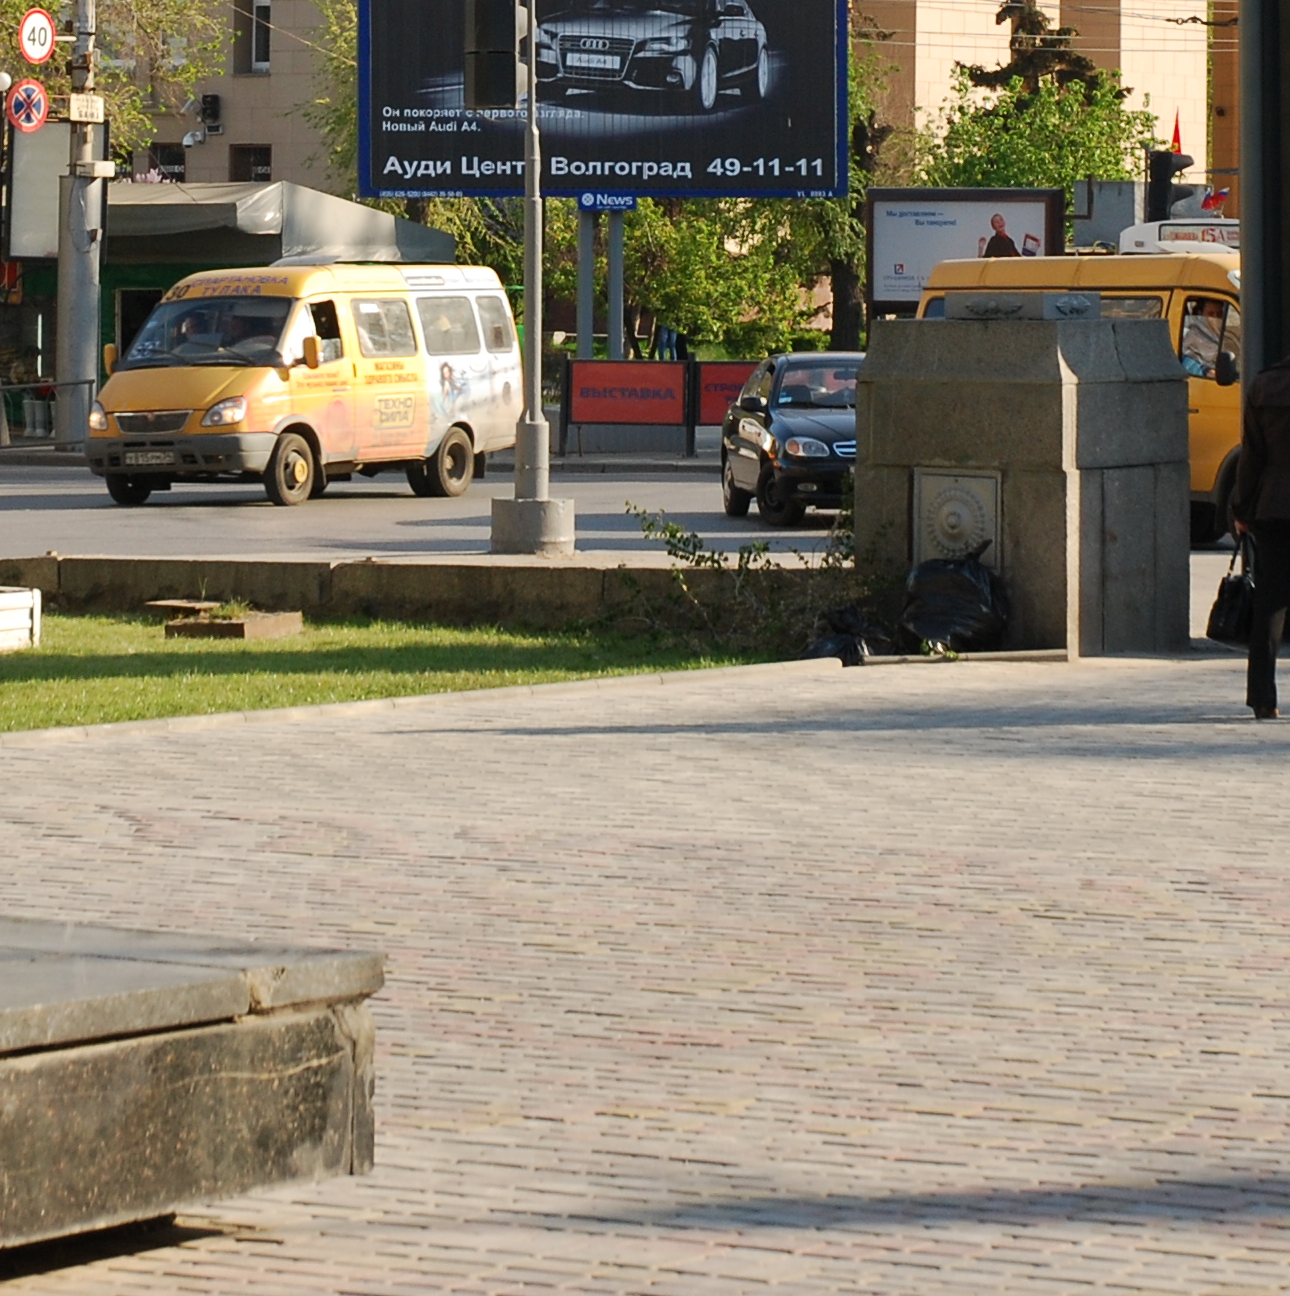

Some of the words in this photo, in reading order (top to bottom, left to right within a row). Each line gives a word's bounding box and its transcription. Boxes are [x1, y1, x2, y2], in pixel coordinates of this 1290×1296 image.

[27, 26, 47, 46] 40
[382, 106, 400, 118] Он
[404, 108, 462, 121] покоряет
[465, 110, 473, 118] с
[382, 120, 425, 132] Новый
[429, 121, 457, 132] Audi
[461, 122, 481, 132] A4.
[383, 156, 451, 179] Ауди
[461, 156, 526, 179] Цент
[551, 157, 692, 180] Волгоград
[706, 158, 823, 177] 49-11-11
[596, 194, 633, 206] News
[203, 285, 261, 296] ТУЛАКА
[580, 387, 676, 400] ВЫСТАВКА
[378, 397, 413, 410] ТЕХНО
[378, 410, 409, 424] СИЛА
